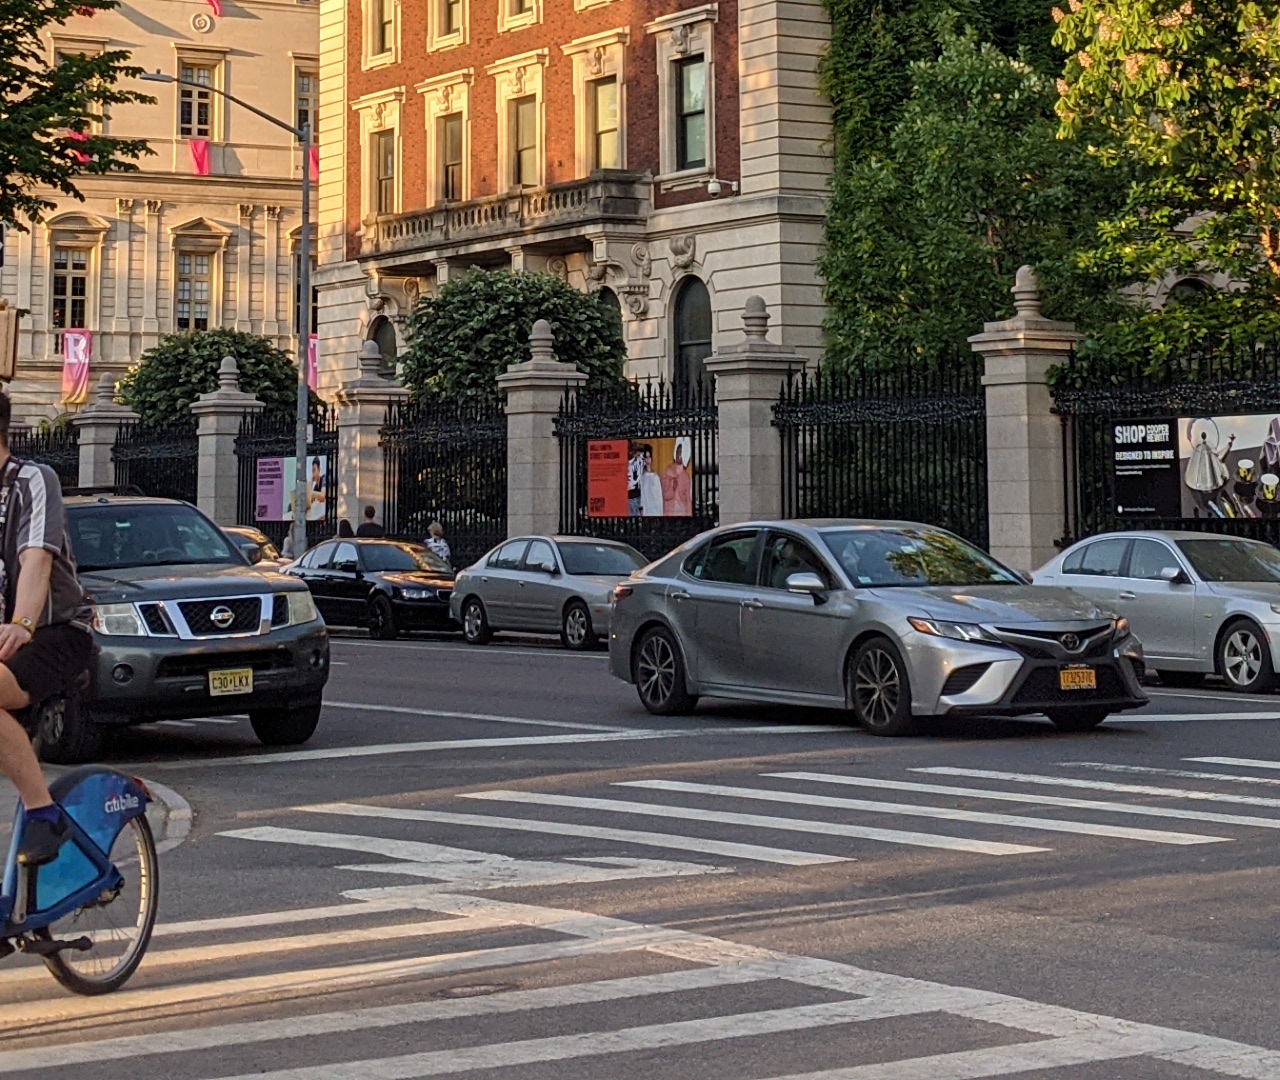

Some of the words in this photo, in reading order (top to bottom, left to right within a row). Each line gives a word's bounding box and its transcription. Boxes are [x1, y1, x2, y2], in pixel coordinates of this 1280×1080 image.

[1114, 424, 1146, 444] SHOP
[1146, 424, 1170, 433] COOPER
[1115, 451, 1143, 460] DESIGNED
[1144, 450, 1152, 459] TO
[1152, 449, 1175, 459] INSPIRE
